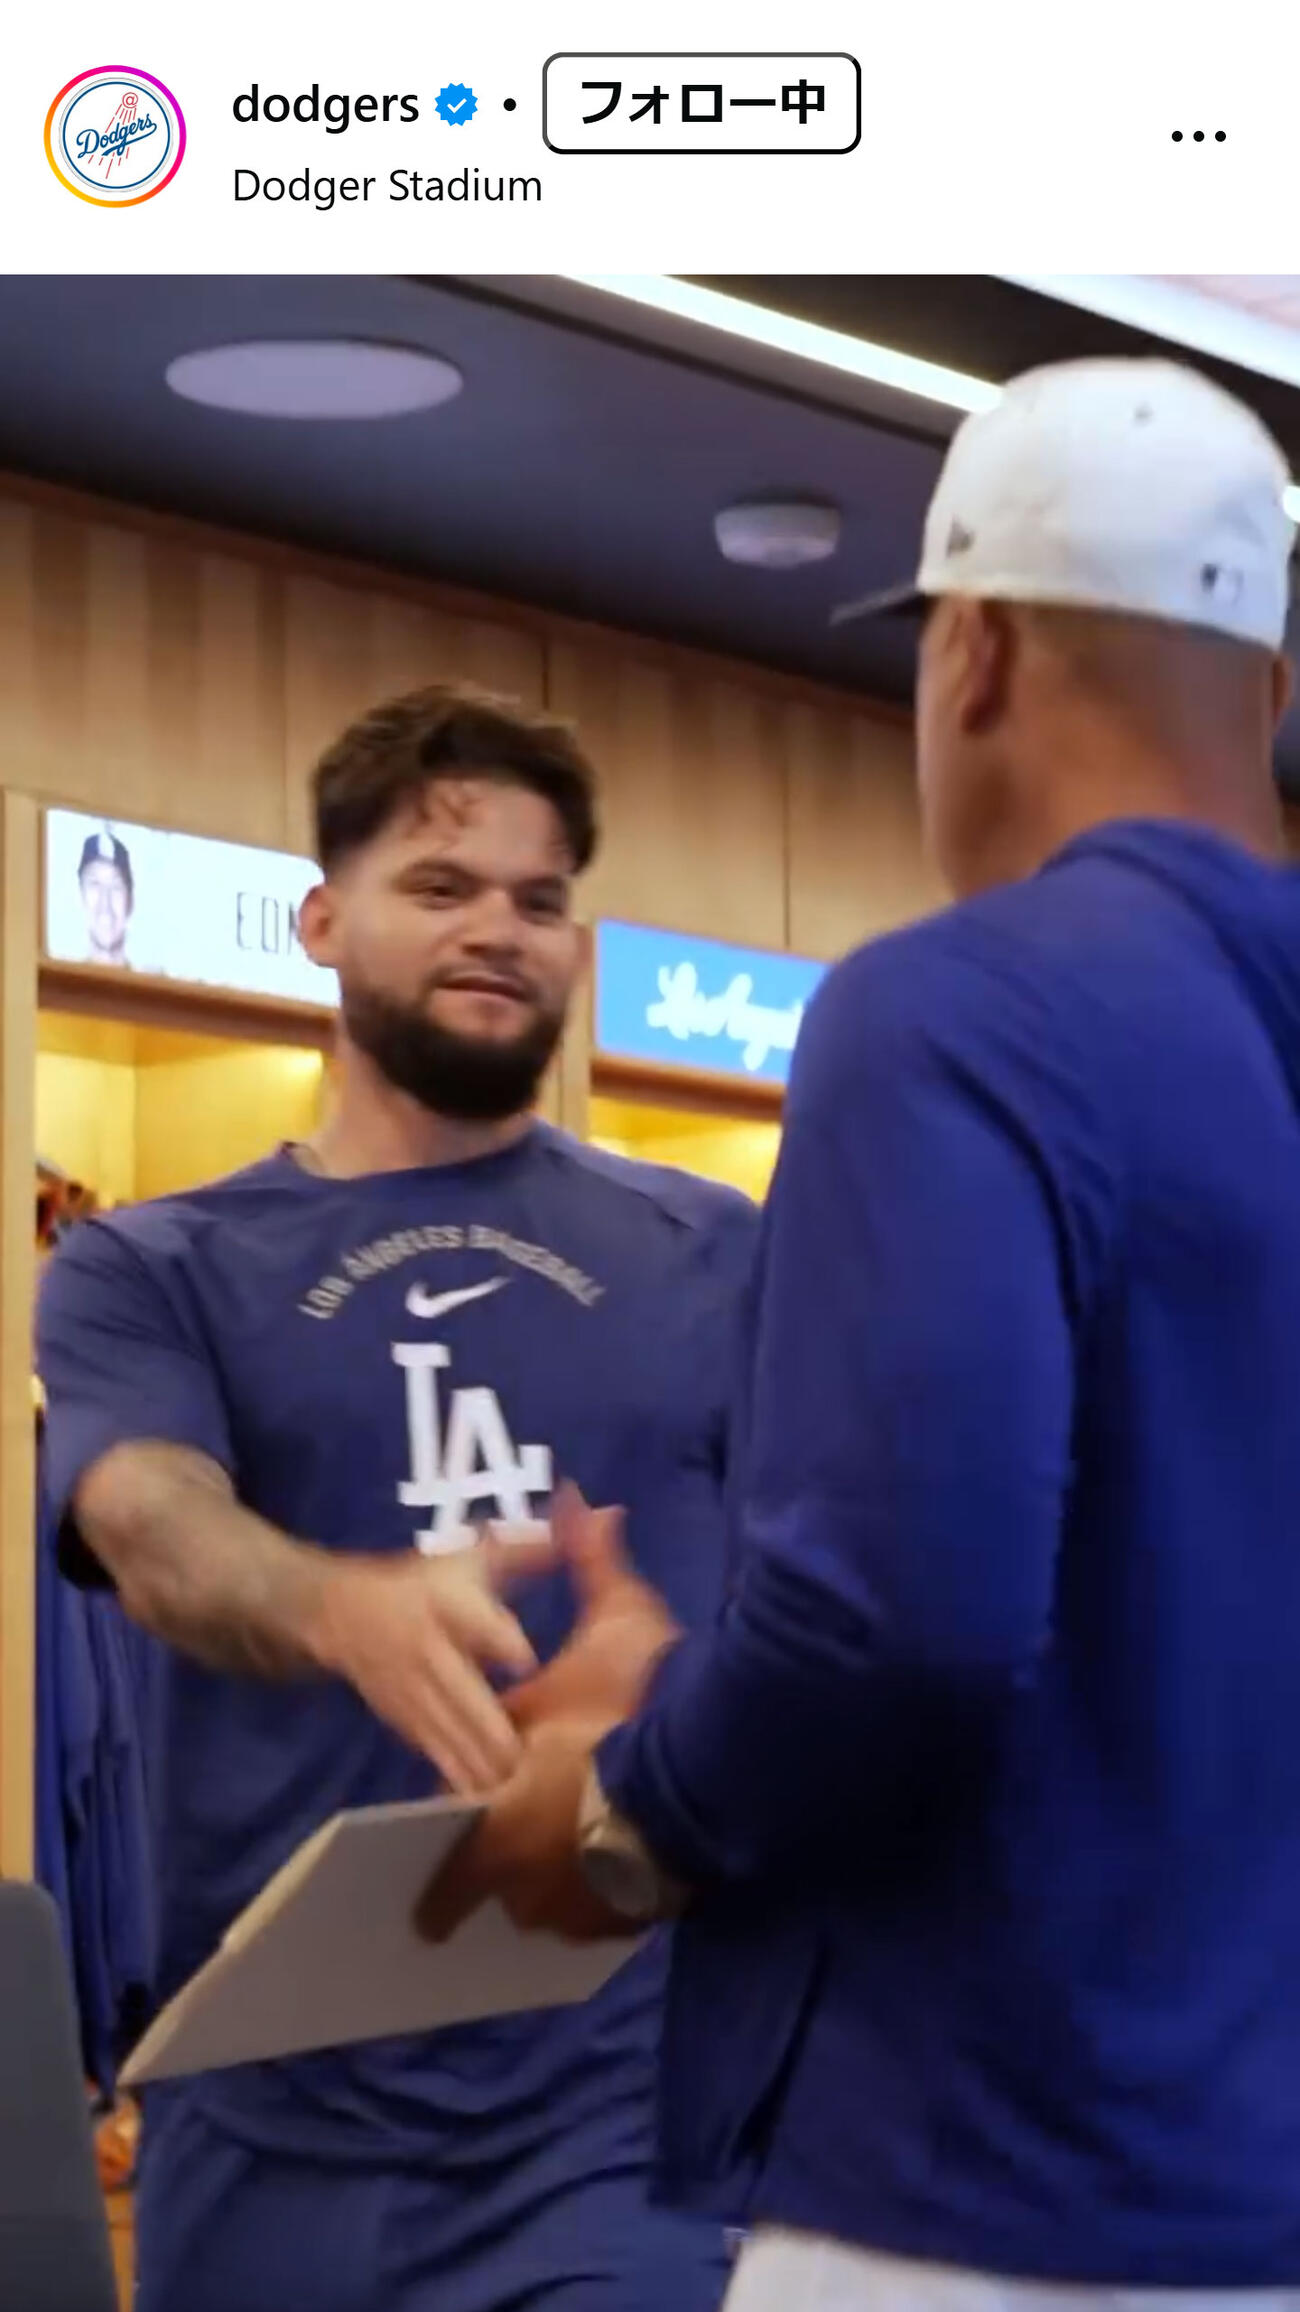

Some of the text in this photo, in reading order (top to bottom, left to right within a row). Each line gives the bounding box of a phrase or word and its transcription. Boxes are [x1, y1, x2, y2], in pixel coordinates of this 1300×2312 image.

[298, 1276, 354, 1320] LOS
[341, 1225, 464, 1281] ANGELES
[391, 1342, 552, 1556] LA
